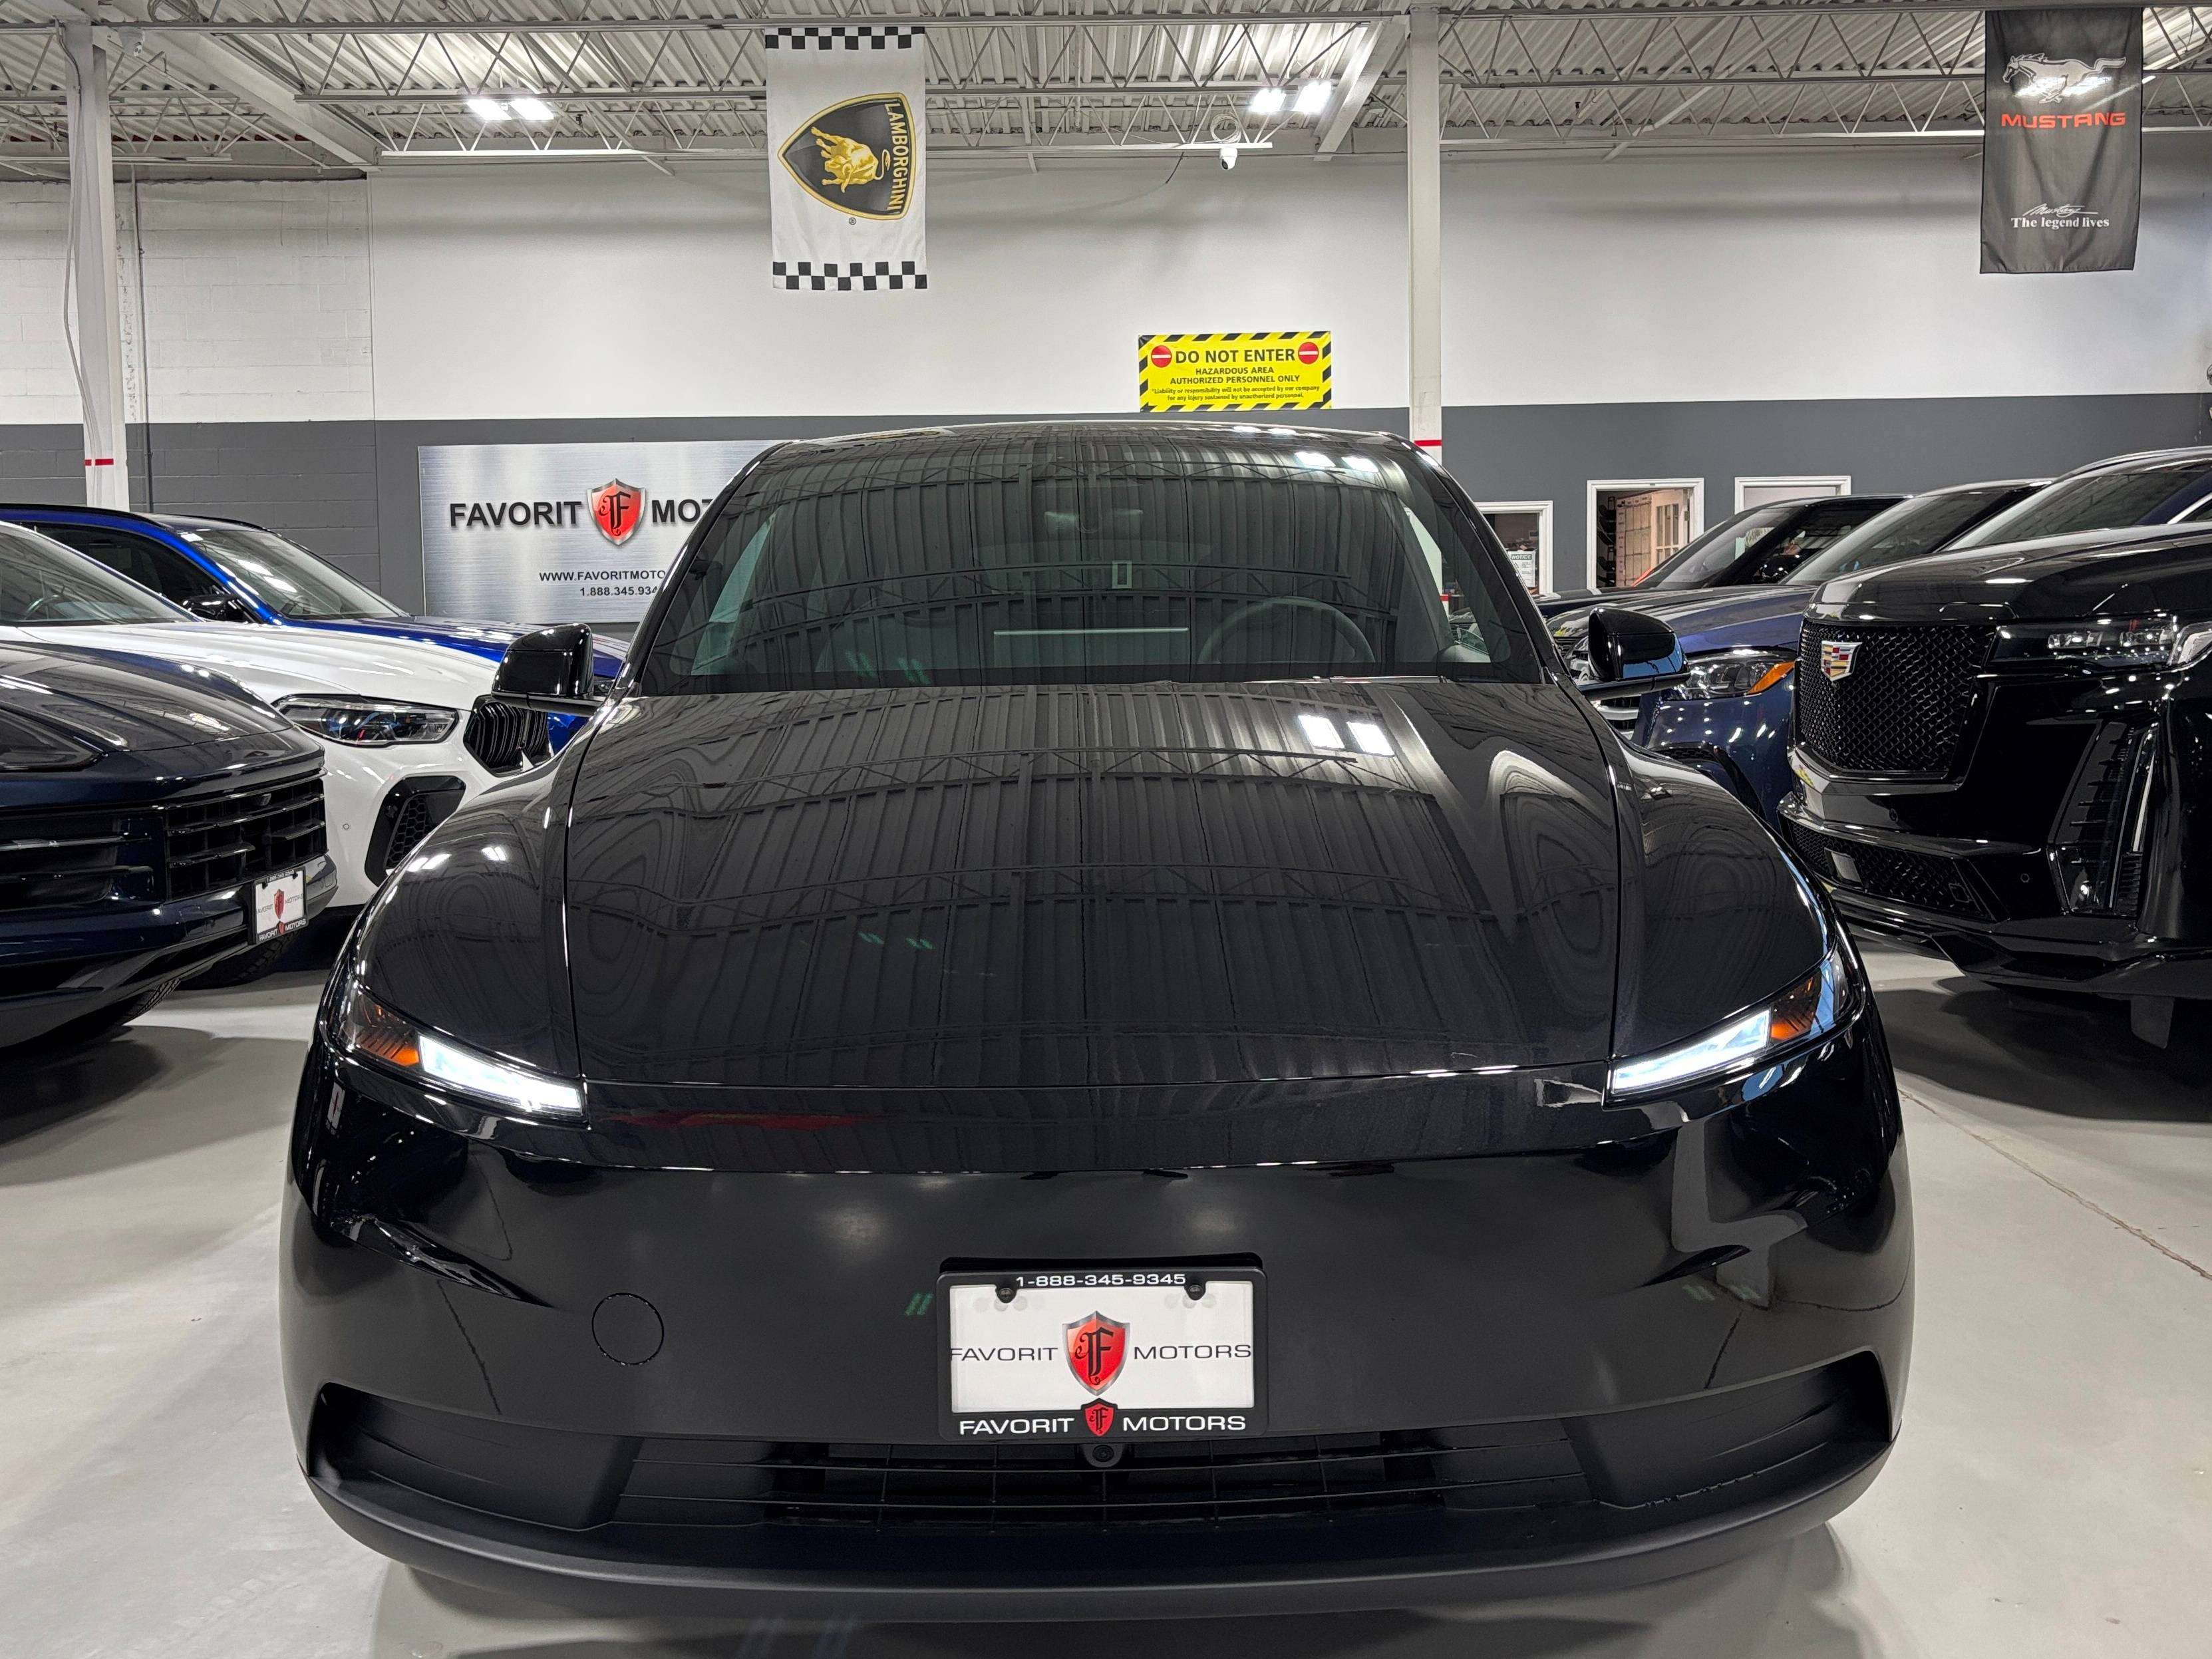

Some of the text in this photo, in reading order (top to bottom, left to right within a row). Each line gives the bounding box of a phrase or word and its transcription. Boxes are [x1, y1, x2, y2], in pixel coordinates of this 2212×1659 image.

[2000, 112, 2126, 128] MUSTANG
[884, 103, 909, 211] LAMBORGHINI
[2011, 217, 2110, 229] The legend lives
[1176, 349, 1295, 364] DO NOT ENTER
[450, 501, 582, 527] FAVORIT
[540, 570, 666, 581] WWW.FAVORITMOTO
[1016, 1273, 1186, 1287] 1-888-345-9345
[951, 1347, 1058, 1361] FAVORIT
[1134, 1344, 1251, 1360] MOTORS
[960, 1418, 1075, 1435] FAVORIT
[1123, 1416, 1246, 1431] MOTORS
